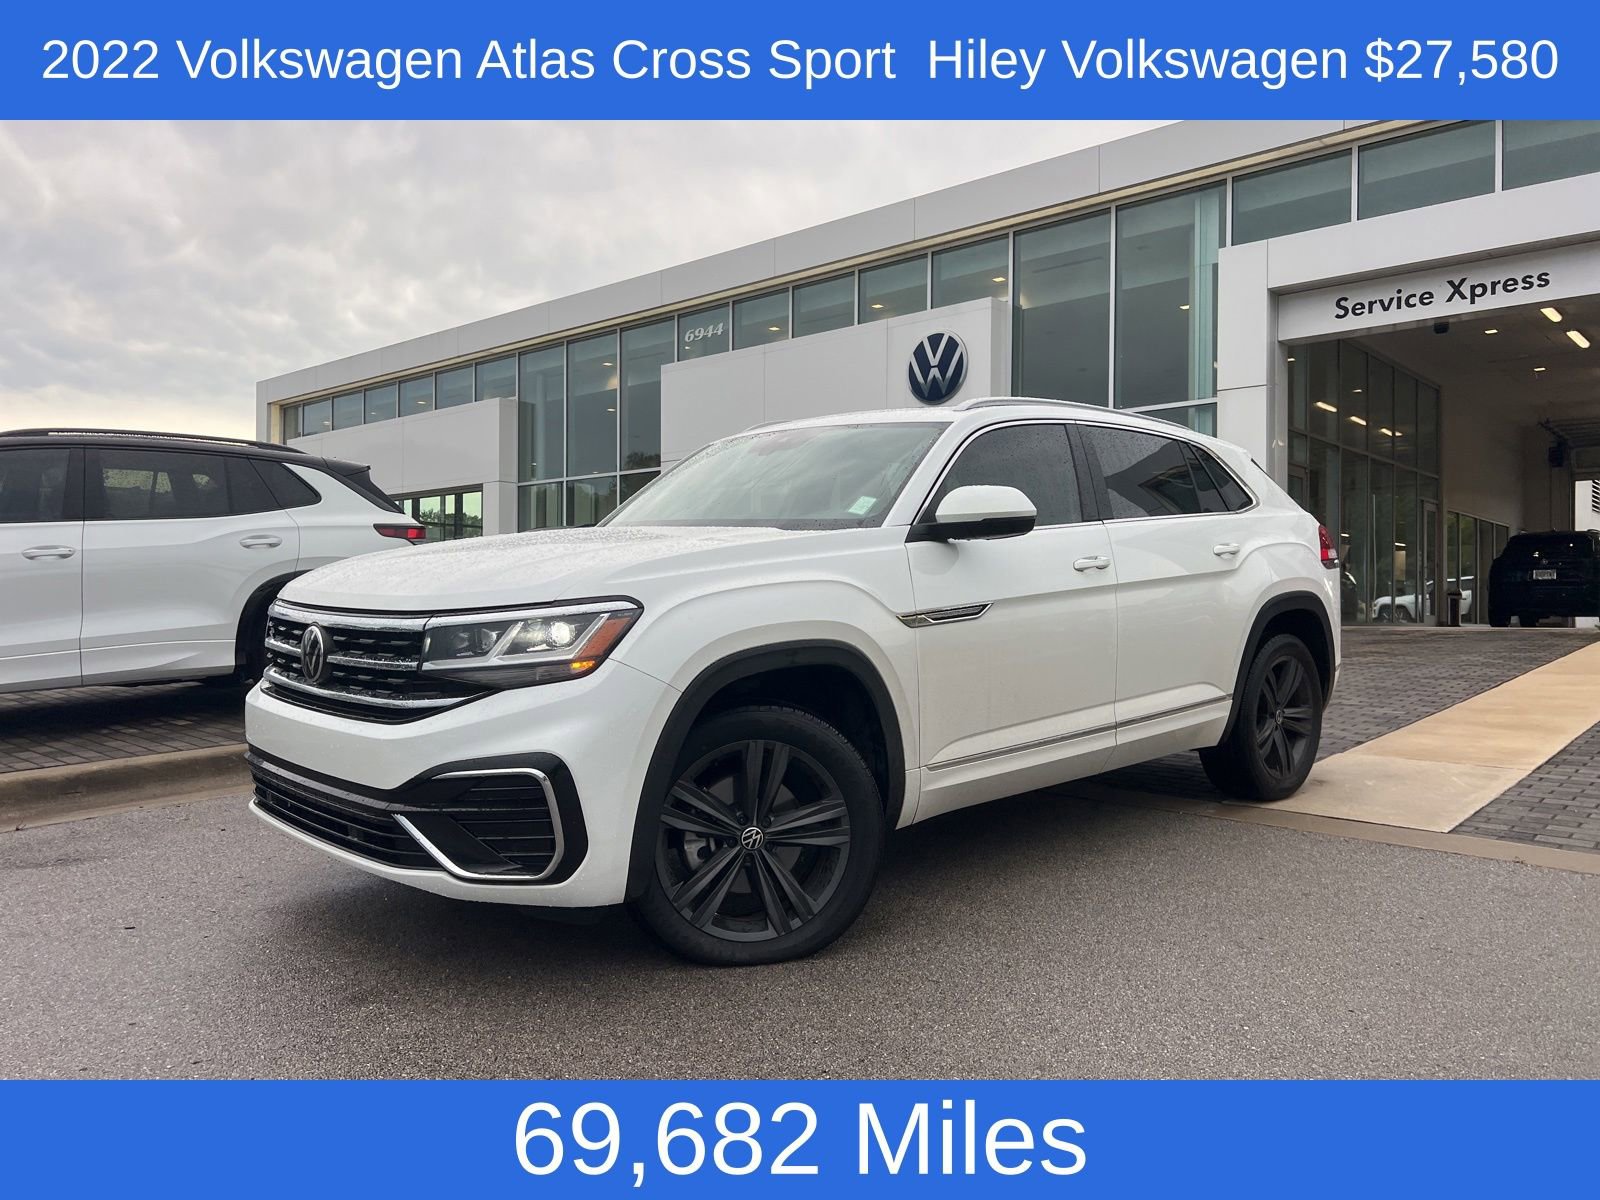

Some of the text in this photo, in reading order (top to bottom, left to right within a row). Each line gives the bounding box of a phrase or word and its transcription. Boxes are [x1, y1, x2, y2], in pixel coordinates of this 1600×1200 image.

[1334, 271, 1550, 319] Service Xpress
[684, 322, 724, 342] 6944
